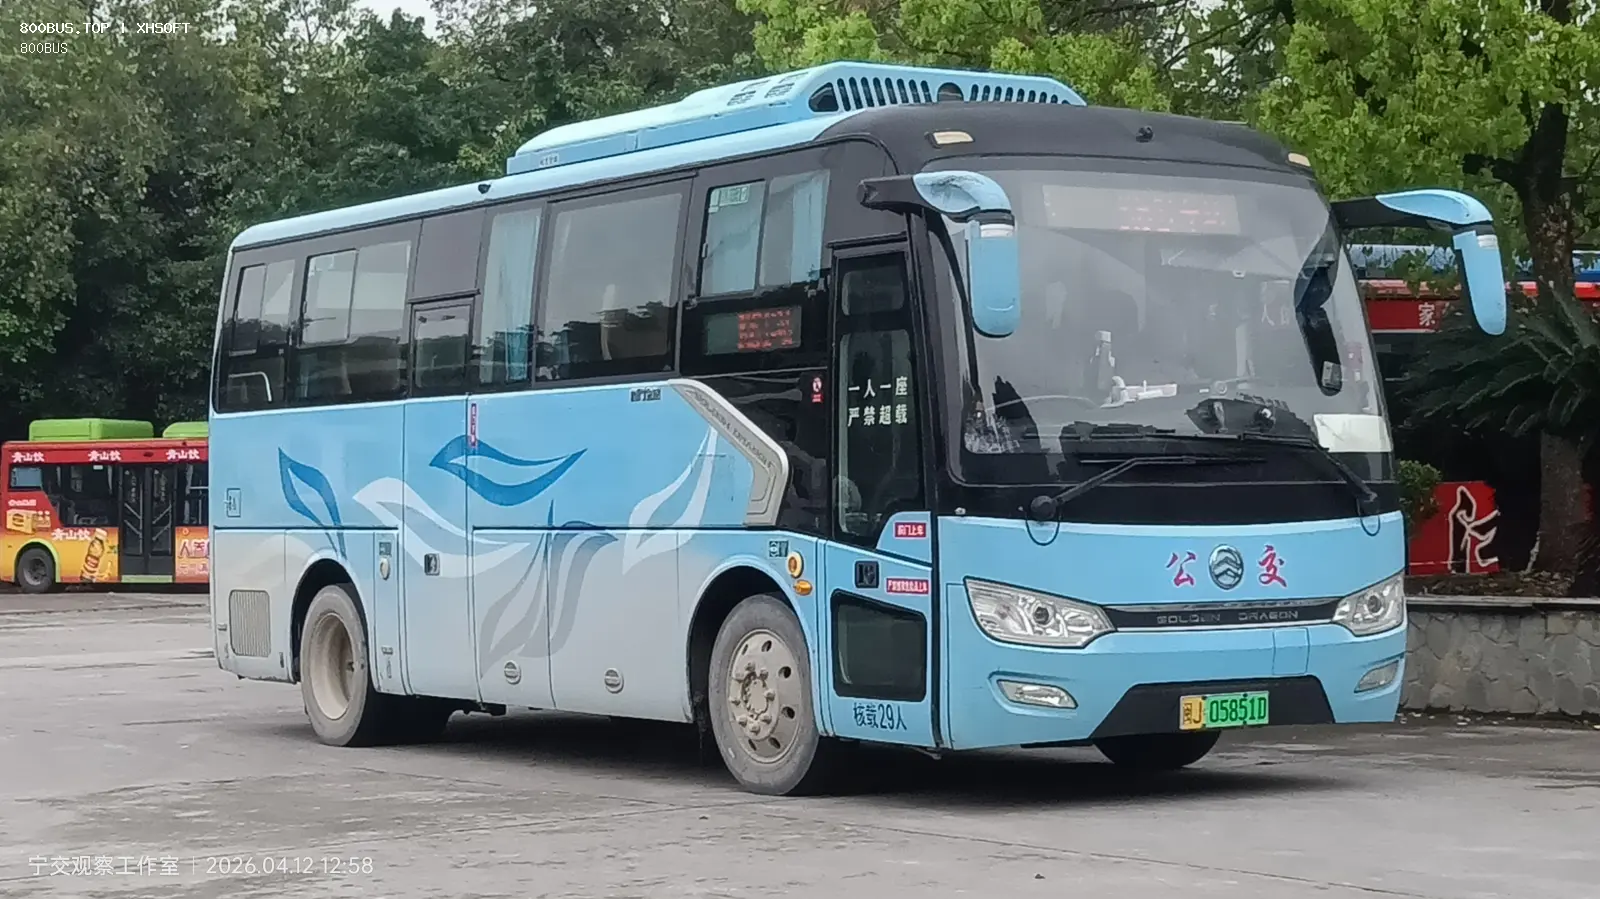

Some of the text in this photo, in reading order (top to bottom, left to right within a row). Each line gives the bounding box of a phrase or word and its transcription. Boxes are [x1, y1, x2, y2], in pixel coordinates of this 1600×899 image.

[848, 375, 908, 399] 一人一座
[847, 403, 908, 427] 严禁超载
[1165, 544, 1288, 588] 公 交
[1238, 610, 1299, 621] DRAGON
